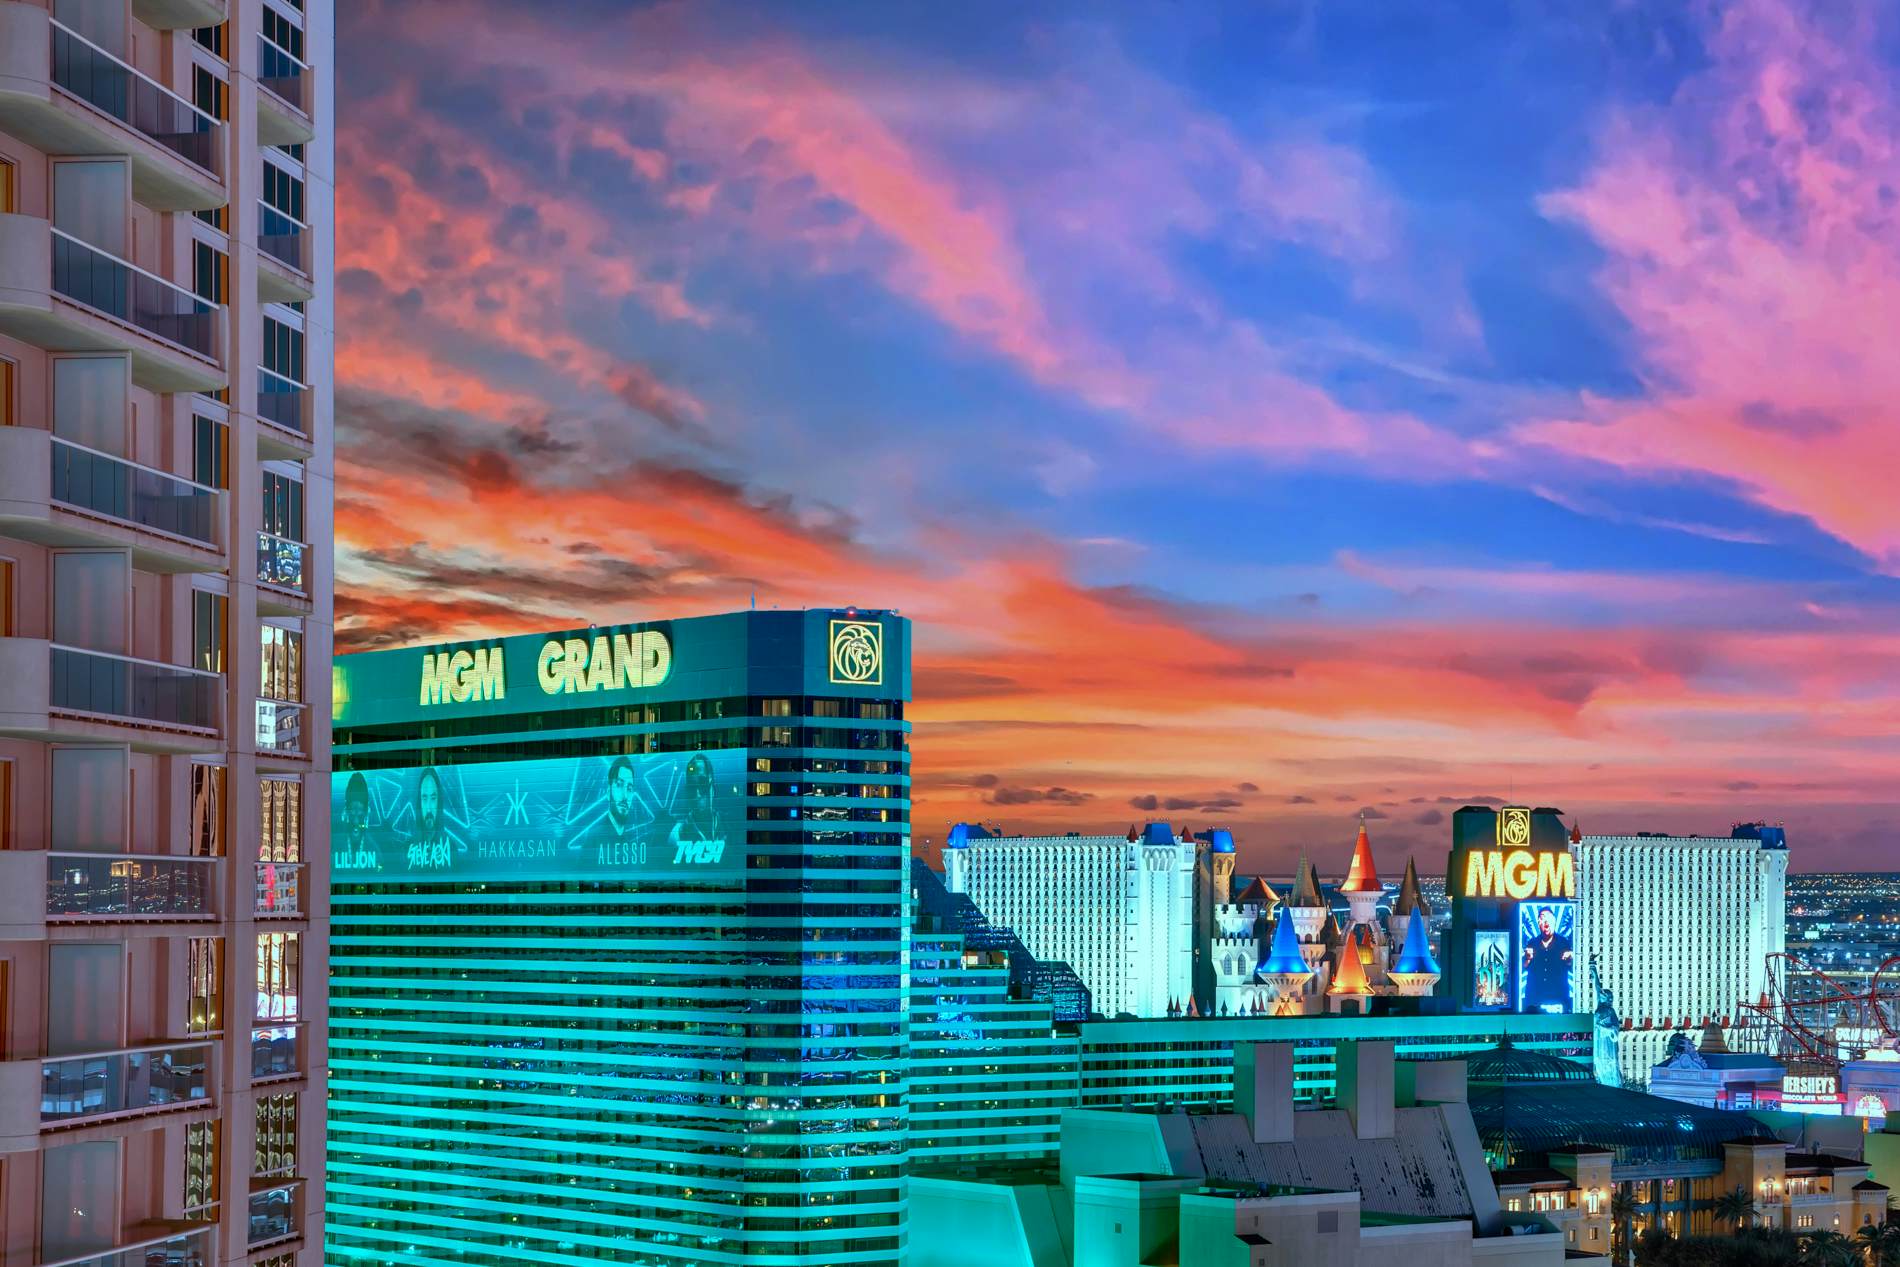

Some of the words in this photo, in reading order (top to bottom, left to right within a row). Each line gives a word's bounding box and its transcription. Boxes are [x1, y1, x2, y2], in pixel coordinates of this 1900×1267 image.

[420, 647, 504, 705] MGM
[538, 631, 672, 694] GRAND
[335, 852, 351, 869] LIL
[353, 851, 376, 868] JON
[478, 840, 557, 858] HAKKASAN
[598, 842, 647, 865] ALESSO
[1465, 850, 1576, 899] MGM
